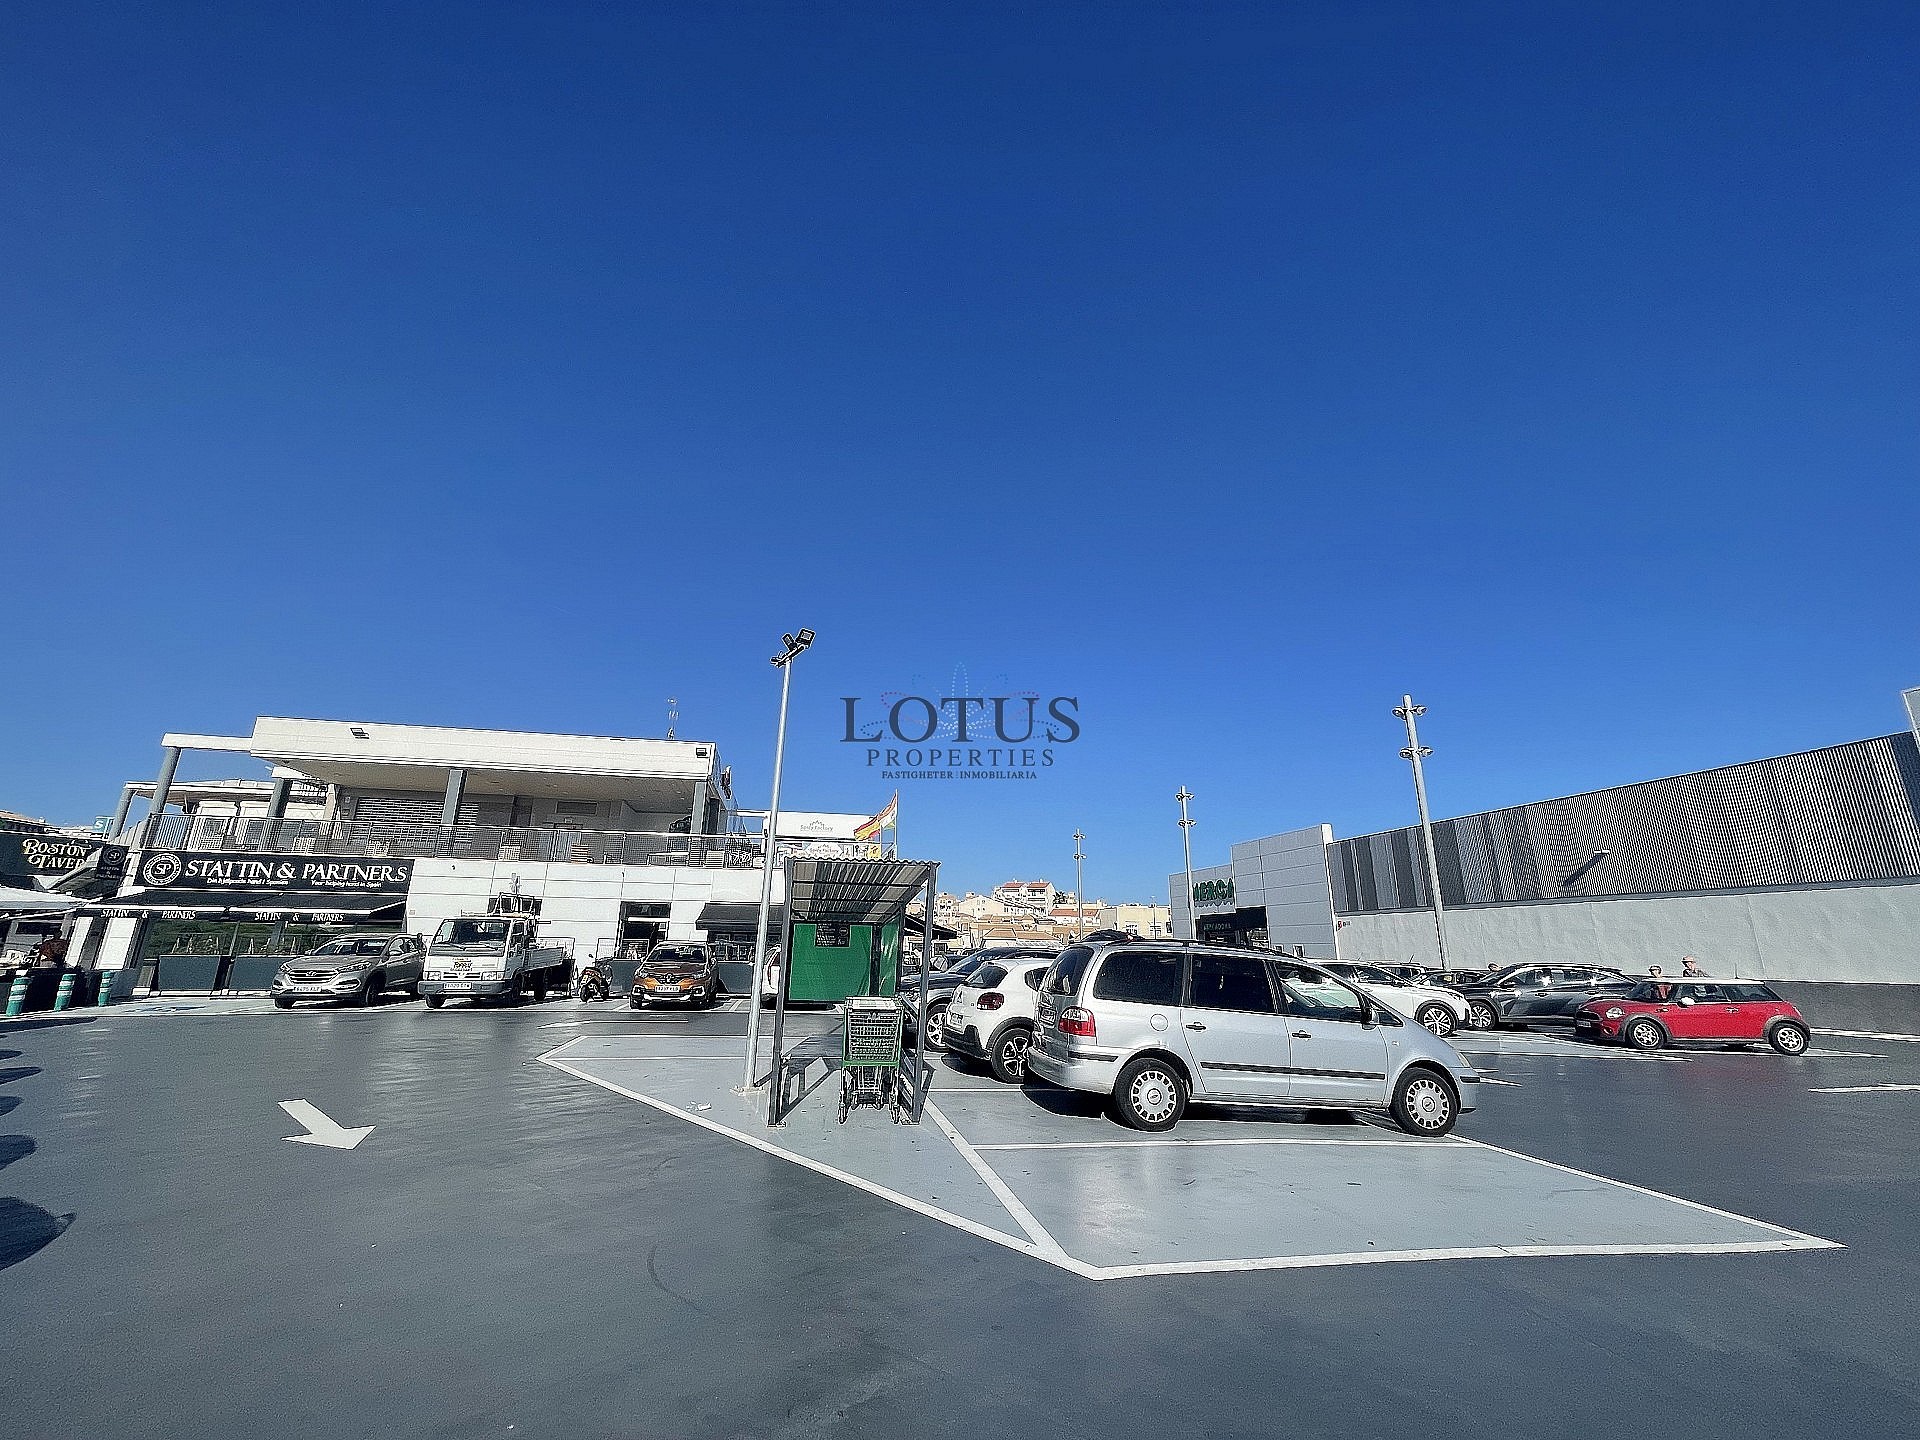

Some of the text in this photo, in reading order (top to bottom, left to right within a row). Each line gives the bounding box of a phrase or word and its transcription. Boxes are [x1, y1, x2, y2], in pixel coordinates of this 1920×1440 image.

[22, 839, 87, 856] BOSTON
[154, 863, 172, 875] SP
[184, 859, 275, 879] STATTIN
[276, 862, 297, 879] &
[301, 863, 408, 882] PARTNERS
[100, 908, 196, 919] STATTIN & PARTNERS
[254, 911, 345, 921] STATTIN & PARTNERS
